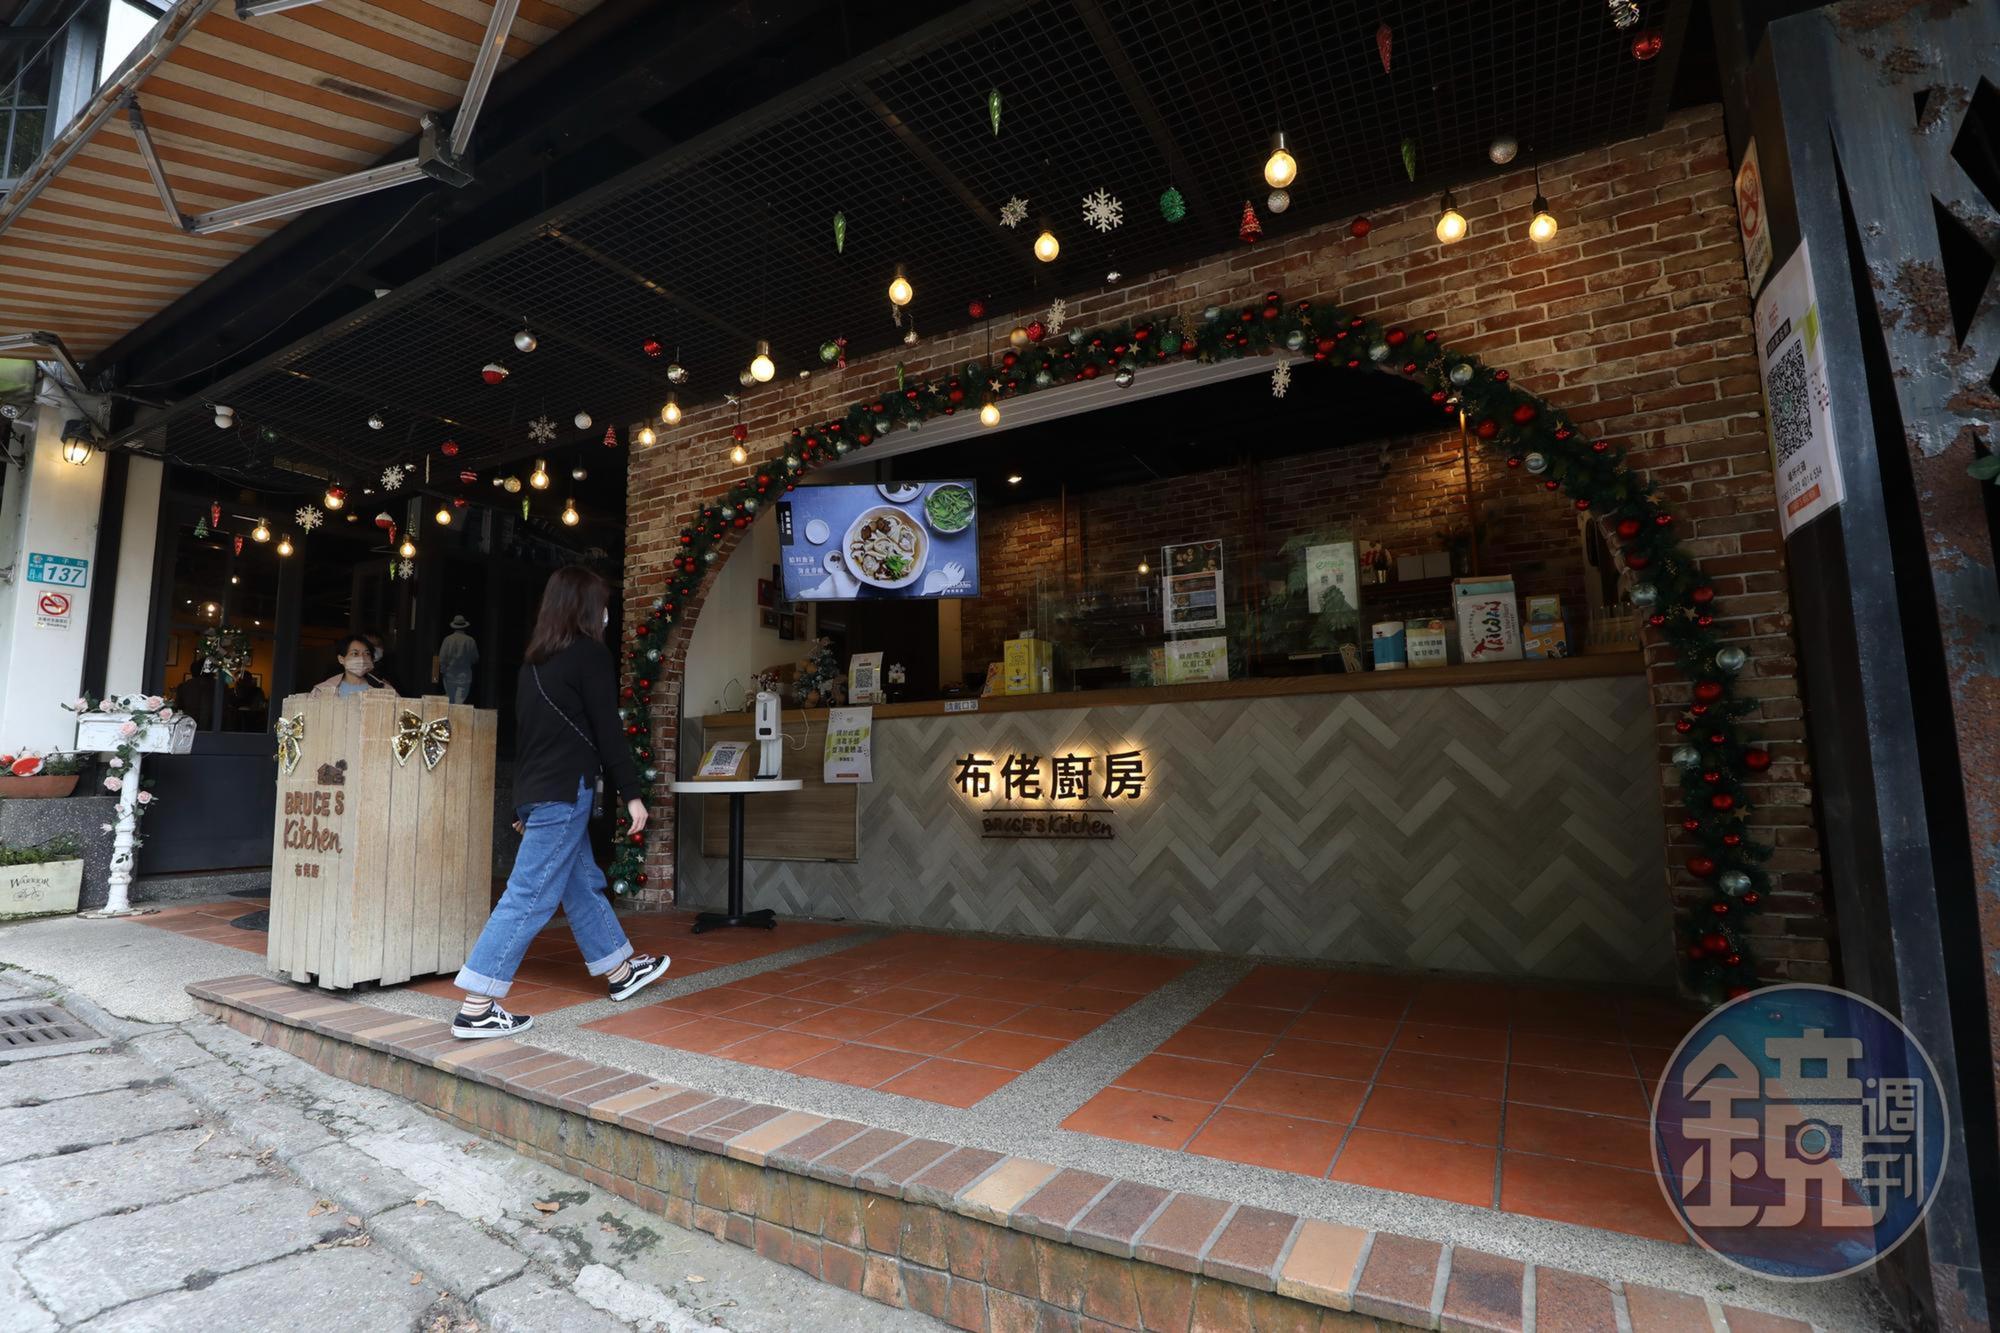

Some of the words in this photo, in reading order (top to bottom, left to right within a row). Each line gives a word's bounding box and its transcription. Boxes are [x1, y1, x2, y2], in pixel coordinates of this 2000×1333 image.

[48, 566, 83, 583] 137
[955, 751, 1146, 800] 布佬廚房
[284, 816, 343, 854] Kitchen
[982, 817, 1046, 834] BRUCE'S
[1048, 813, 1115, 837] Kitchen
